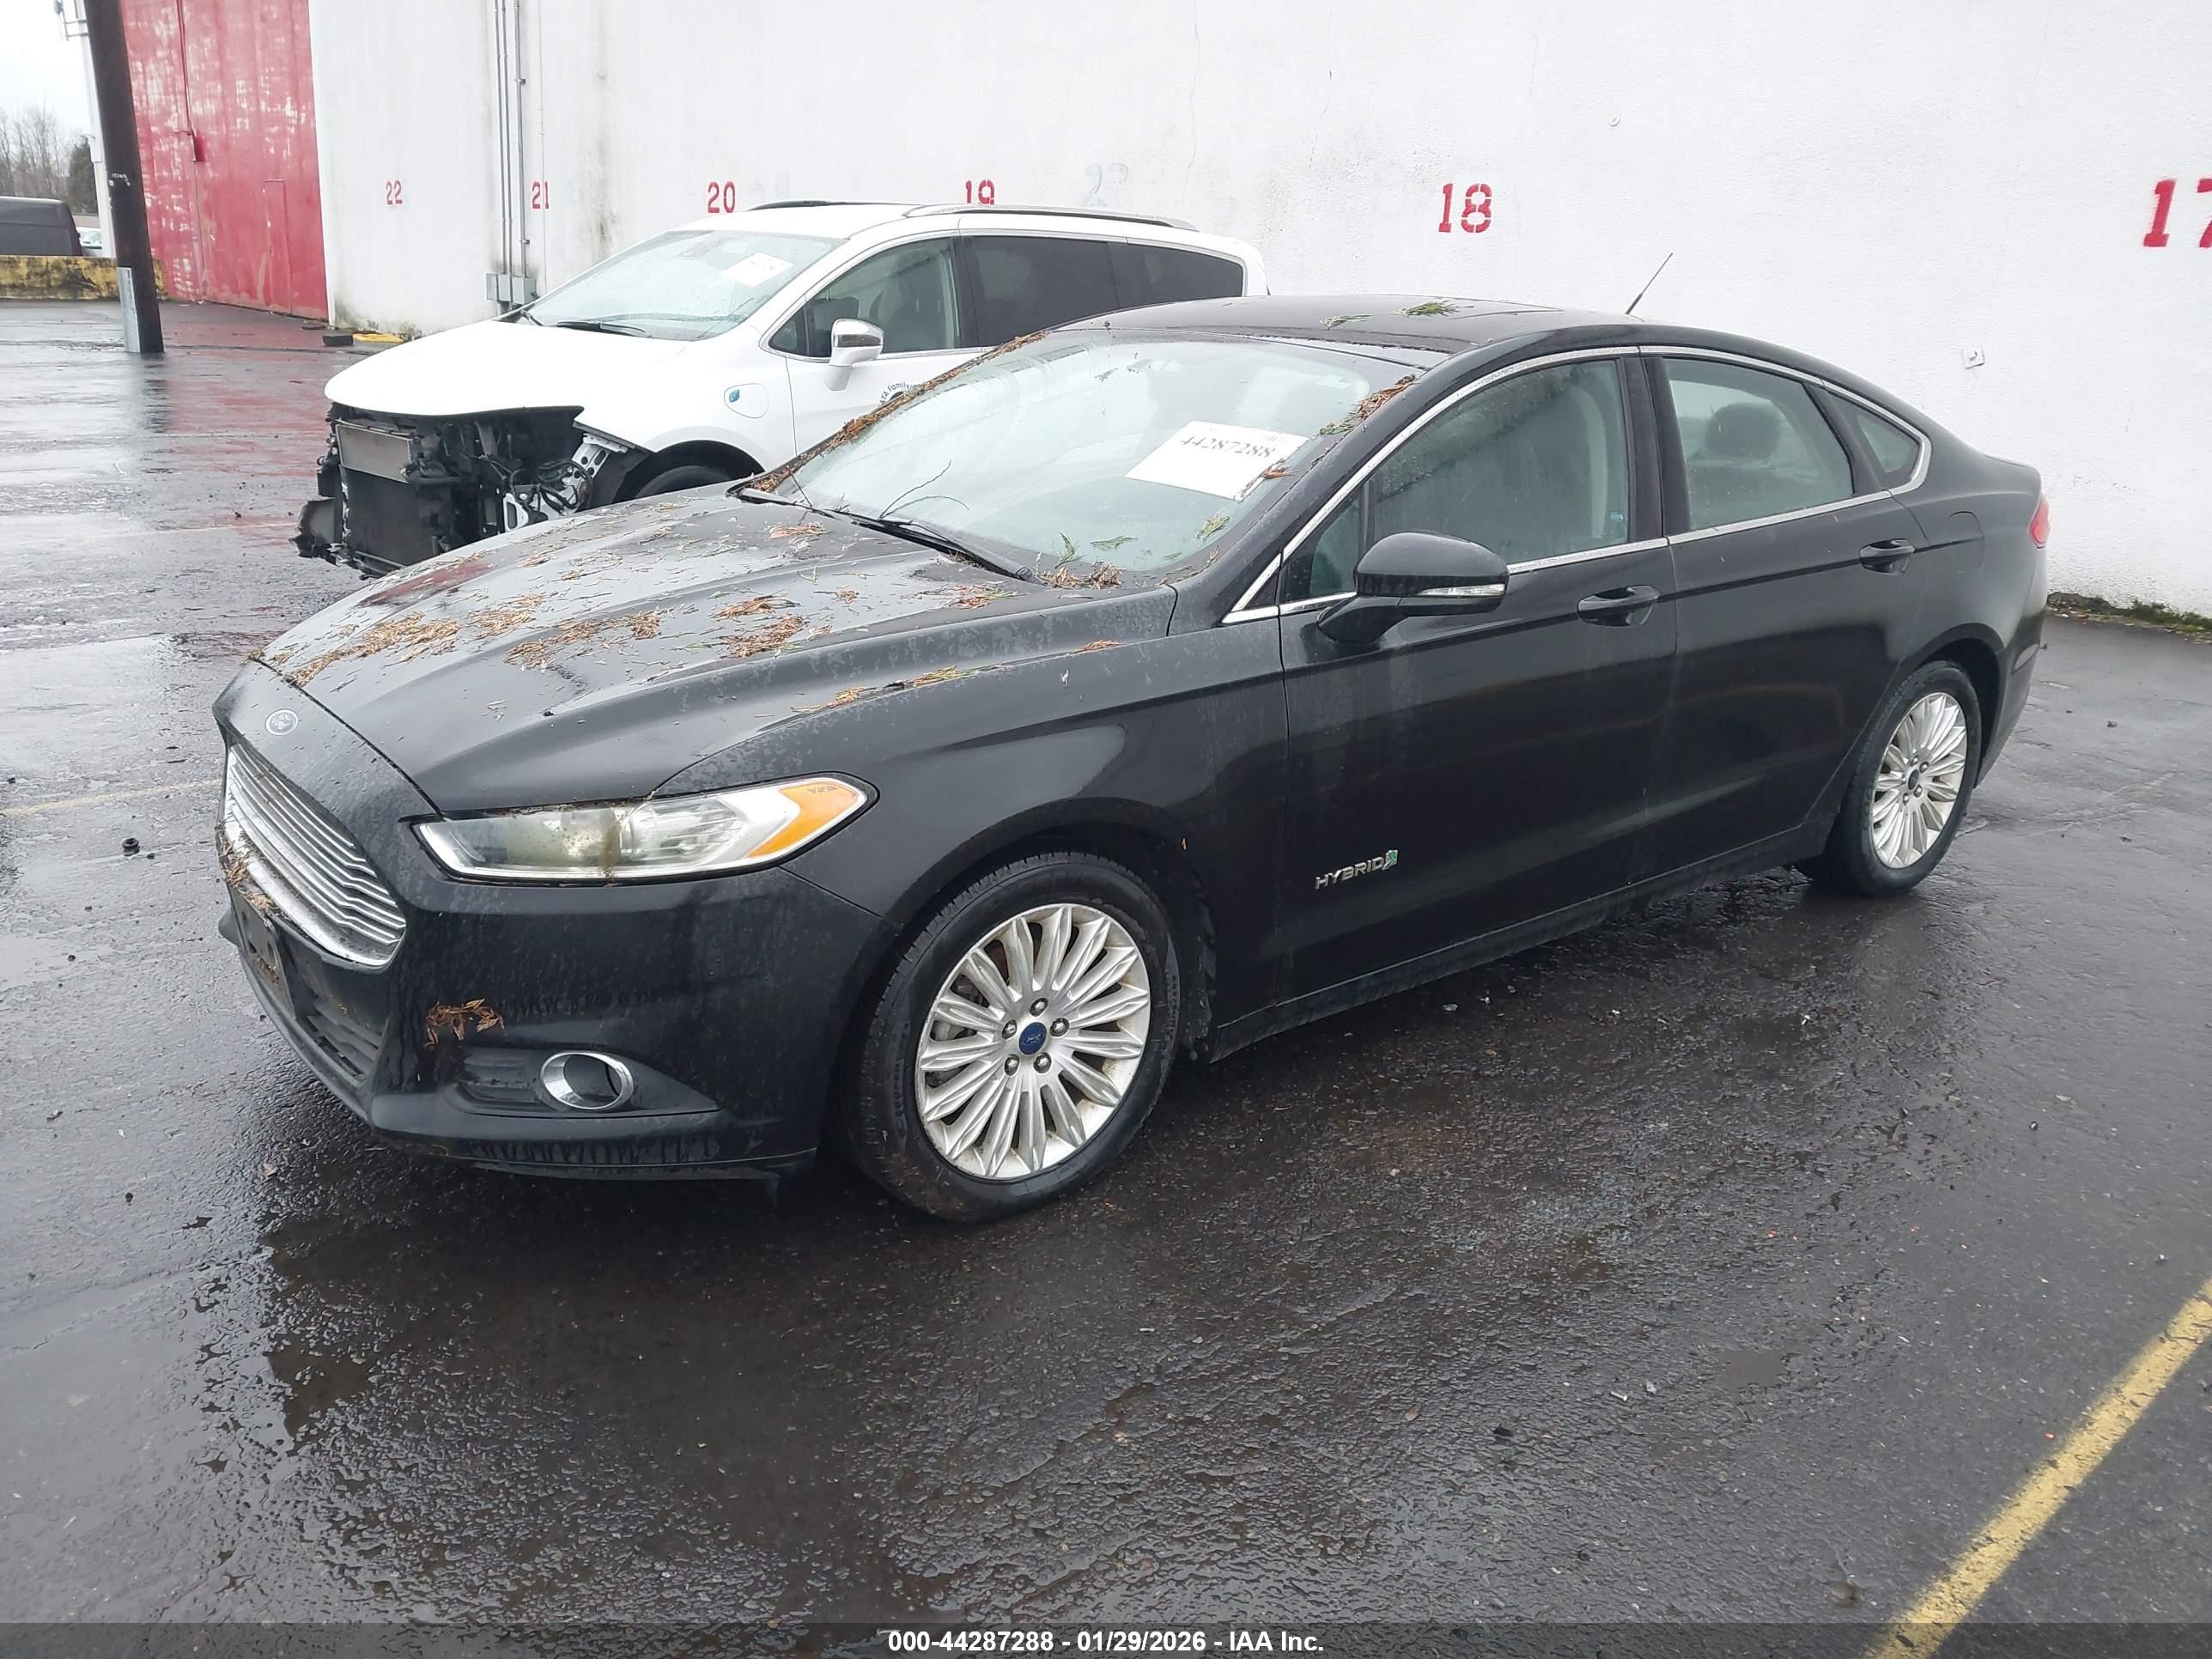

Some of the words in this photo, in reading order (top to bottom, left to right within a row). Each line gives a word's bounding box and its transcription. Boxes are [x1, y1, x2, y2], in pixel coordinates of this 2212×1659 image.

[386, 179, 403, 204] 22
[532, 181, 550, 209] 21
[708, 180, 735, 214] 20
[965, 179, 994, 204] 19
[1438, 183, 1492, 233] 18
[1181, 436, 1275, 457] 44287288
[1315, 856, 1385, 890] HYBRID
